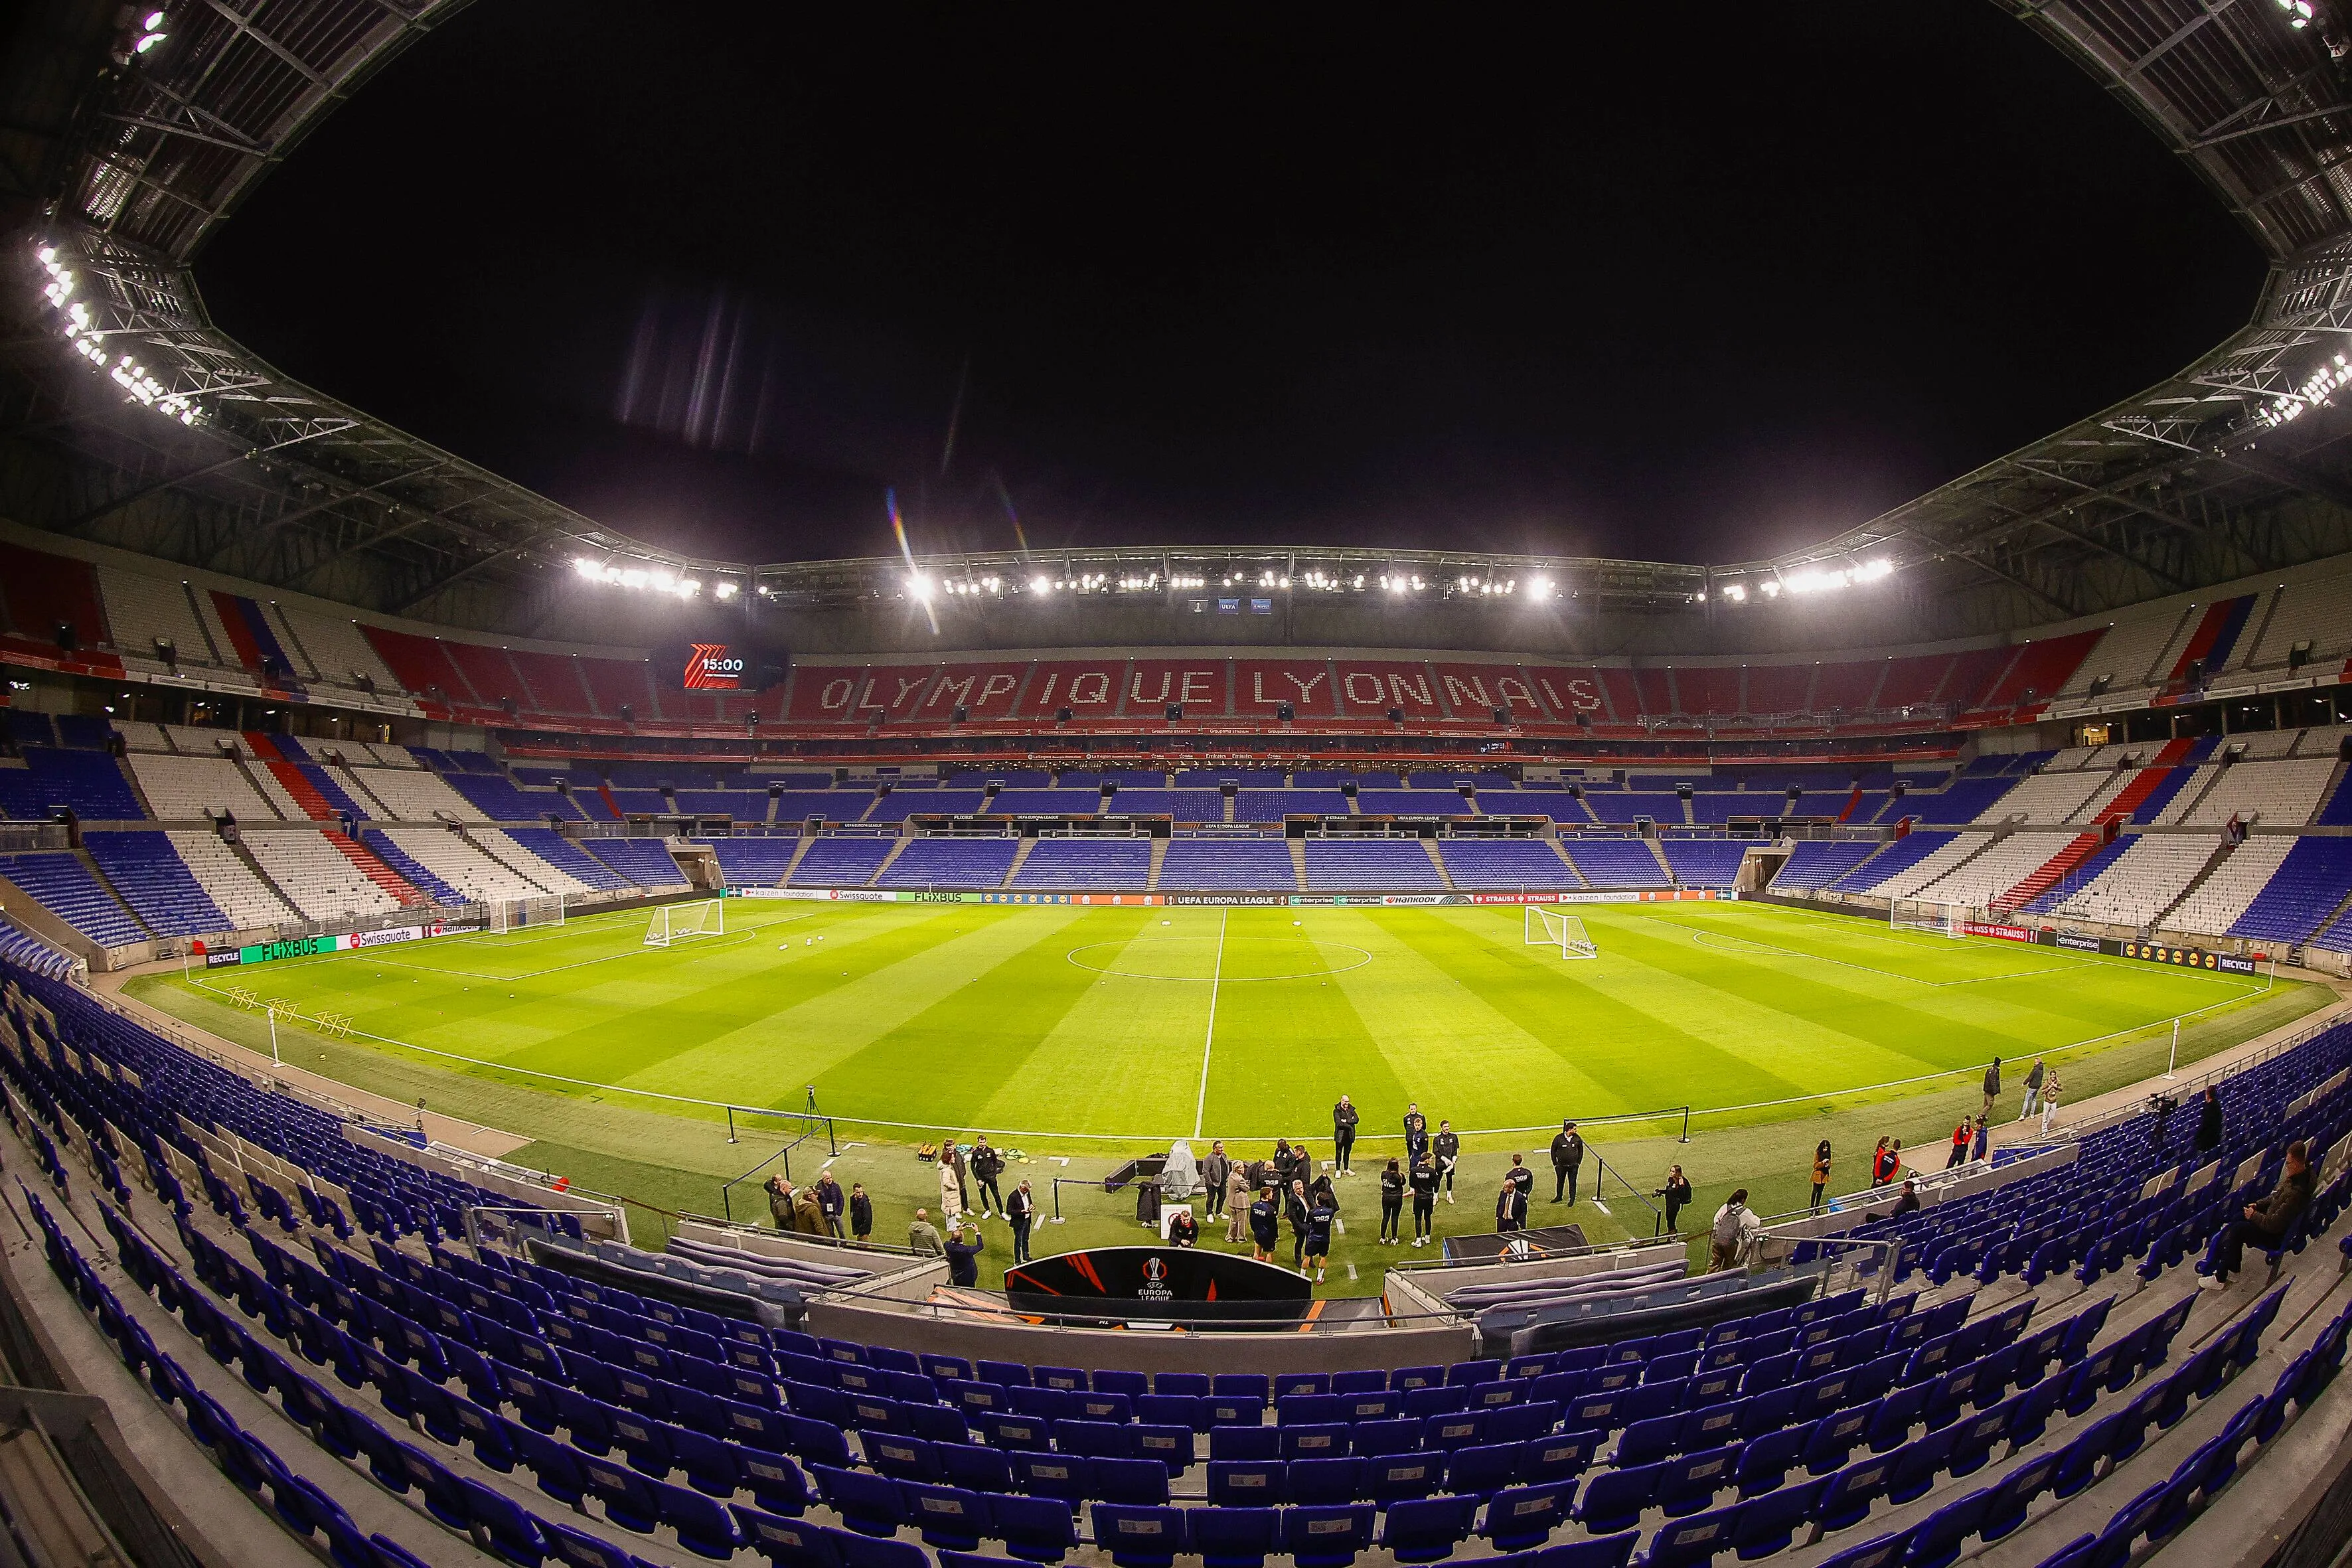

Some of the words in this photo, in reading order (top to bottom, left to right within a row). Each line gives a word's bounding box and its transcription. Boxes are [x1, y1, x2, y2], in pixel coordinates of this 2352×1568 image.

[702, 658, 744, 671] 15:00
[821, 672, 1213, 709] OLYMPIQUE
[1254, 672, 1601, 710] LYONNAIS
[839, 891, 882, 901] Swissquote
[361, 931, 410, 946] Swissquote
[1995, 927, 2025, 939] STRAUSS
[2058, 936, 2098, 949] enterprise
[208, 952, 239, 964] RECYCLE
[2221, 959, 2253, 971] RECYCLE
